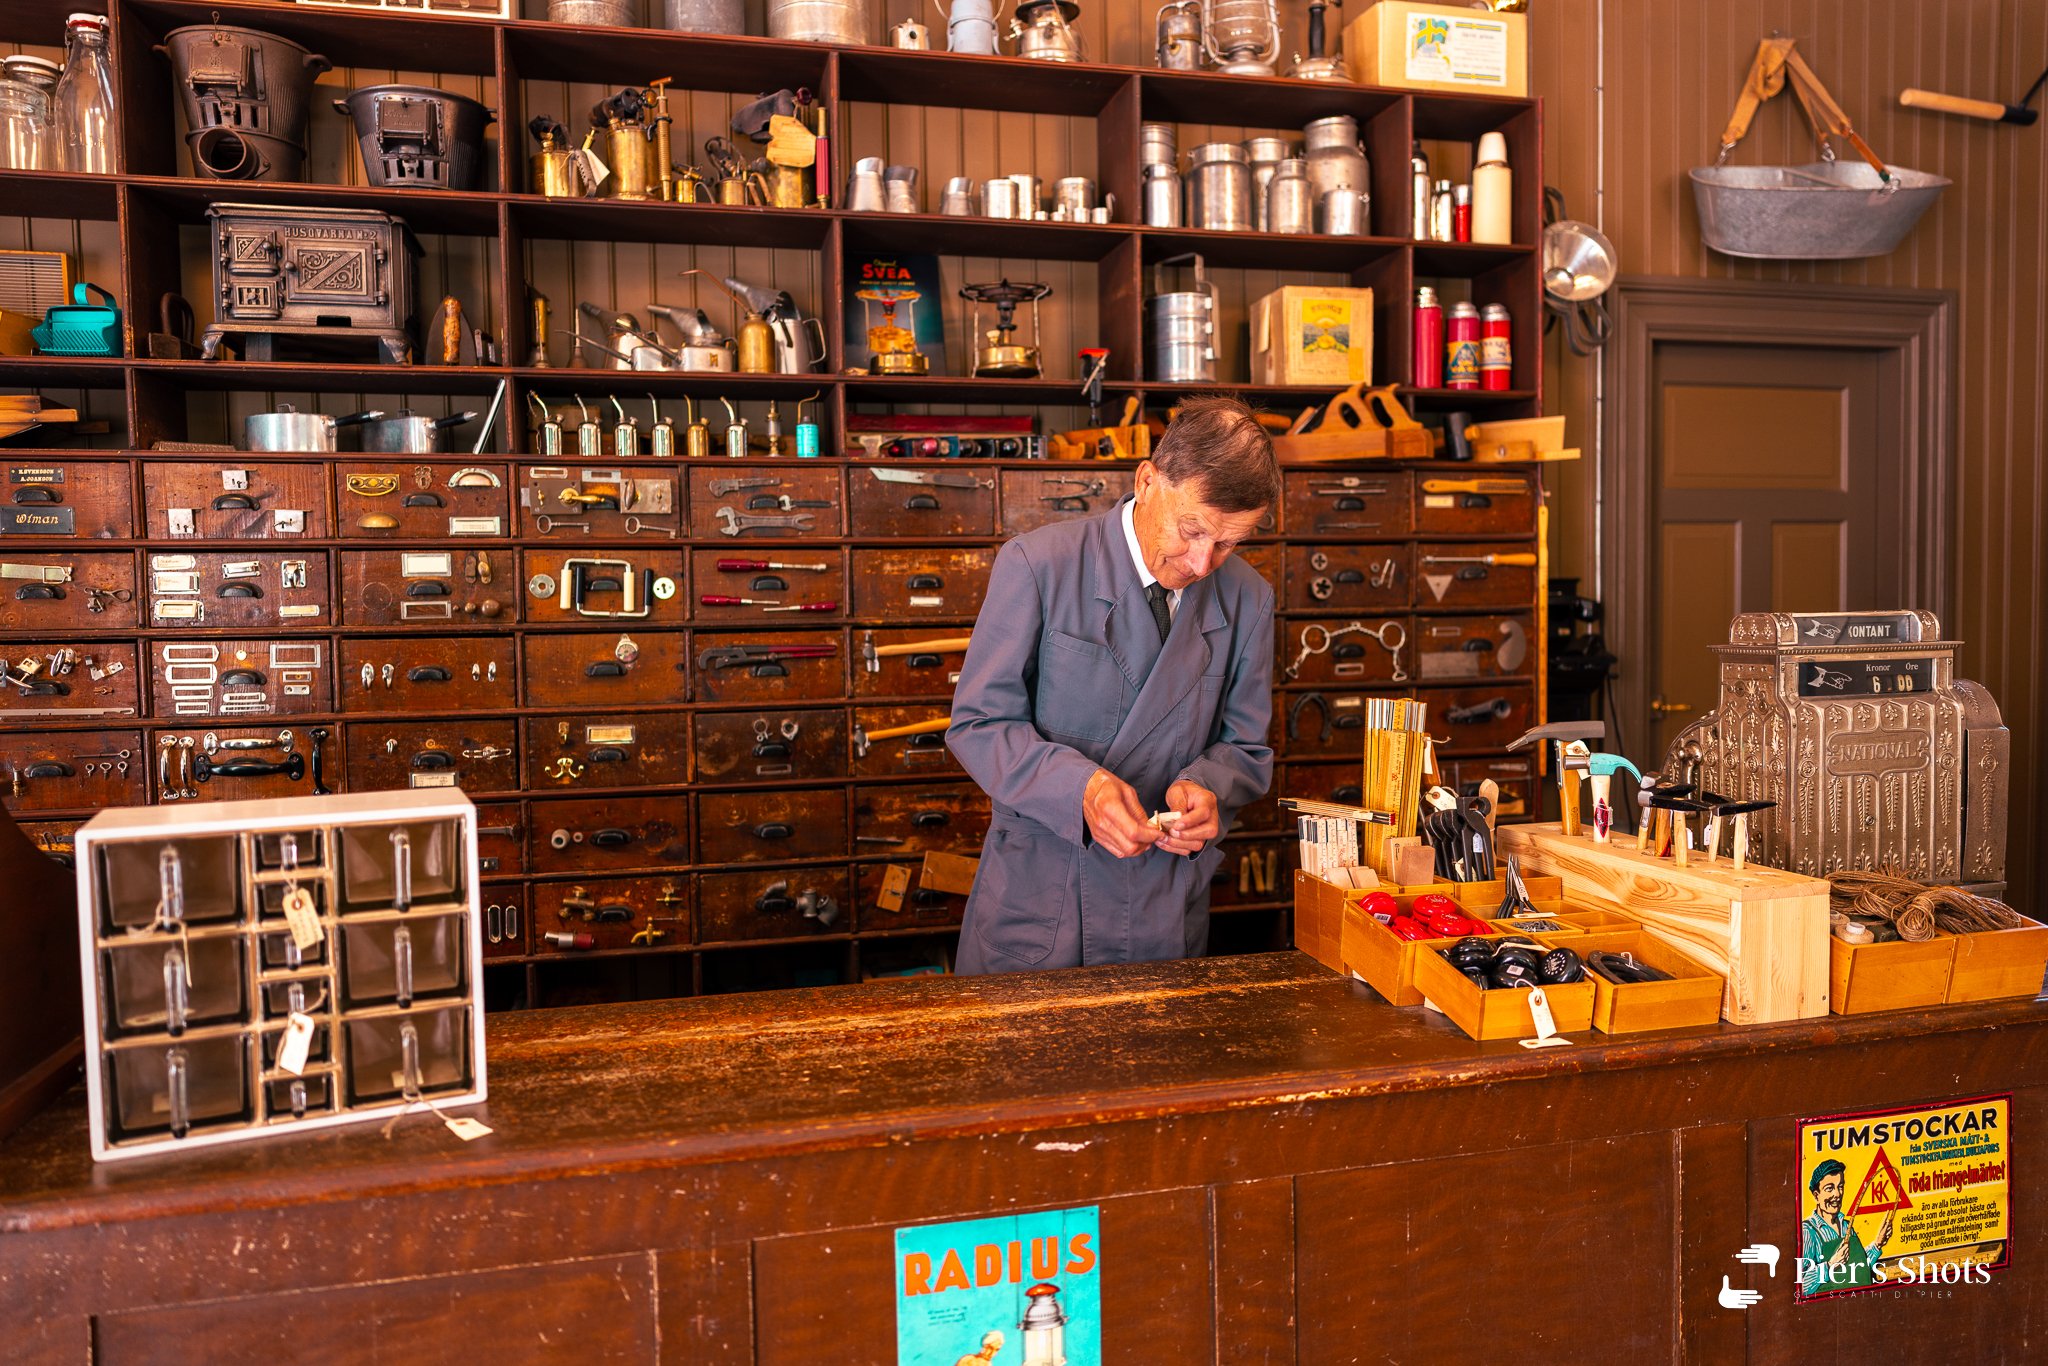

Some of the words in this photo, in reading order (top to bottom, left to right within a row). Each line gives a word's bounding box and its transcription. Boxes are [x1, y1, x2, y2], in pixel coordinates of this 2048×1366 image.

[862, 263, 911, 279] SVEA
[1866, 664, 1891, 672] Kronor
[1872, 675, 1881, 693] 6
[1839, 741, 1917, 761] NATIONAL
[1813, 1108, 1998, 1152] TUMSTOCKAR
[1922, 1138, 1958, 1151] SVENSKA
[1909, 1171, 1931, 1193] röda
[1932, 1160, 2005, 1193] triangelmärket
[1901, 1212, 1924, 1223] erkända
[1926, 1212, 1937, 1220] som
[1939, 1209, 1946, 1218] de
[1946, 1206, 1968, 1217] absolut
[1969, 1204, 1985, 1213] bästa
[1986, 1200, 1997, 1209] och
[1921, 1202, 1930, 1211] äro
[1939, 1199, 1948, 1208] alla
[1900, 1222, 1926, 1233] billigaste
[1926, 1220, 1934, 1231] på
[1934, 1217, 1950, 1229] grund
[1919, 1229, 1946, 1241] noggranna
[1984, 1219, 1999, 1229] samt
[1920, 1240, 1934, 1251] goda
[904, 1233, 1097, 1297] RADIUS
